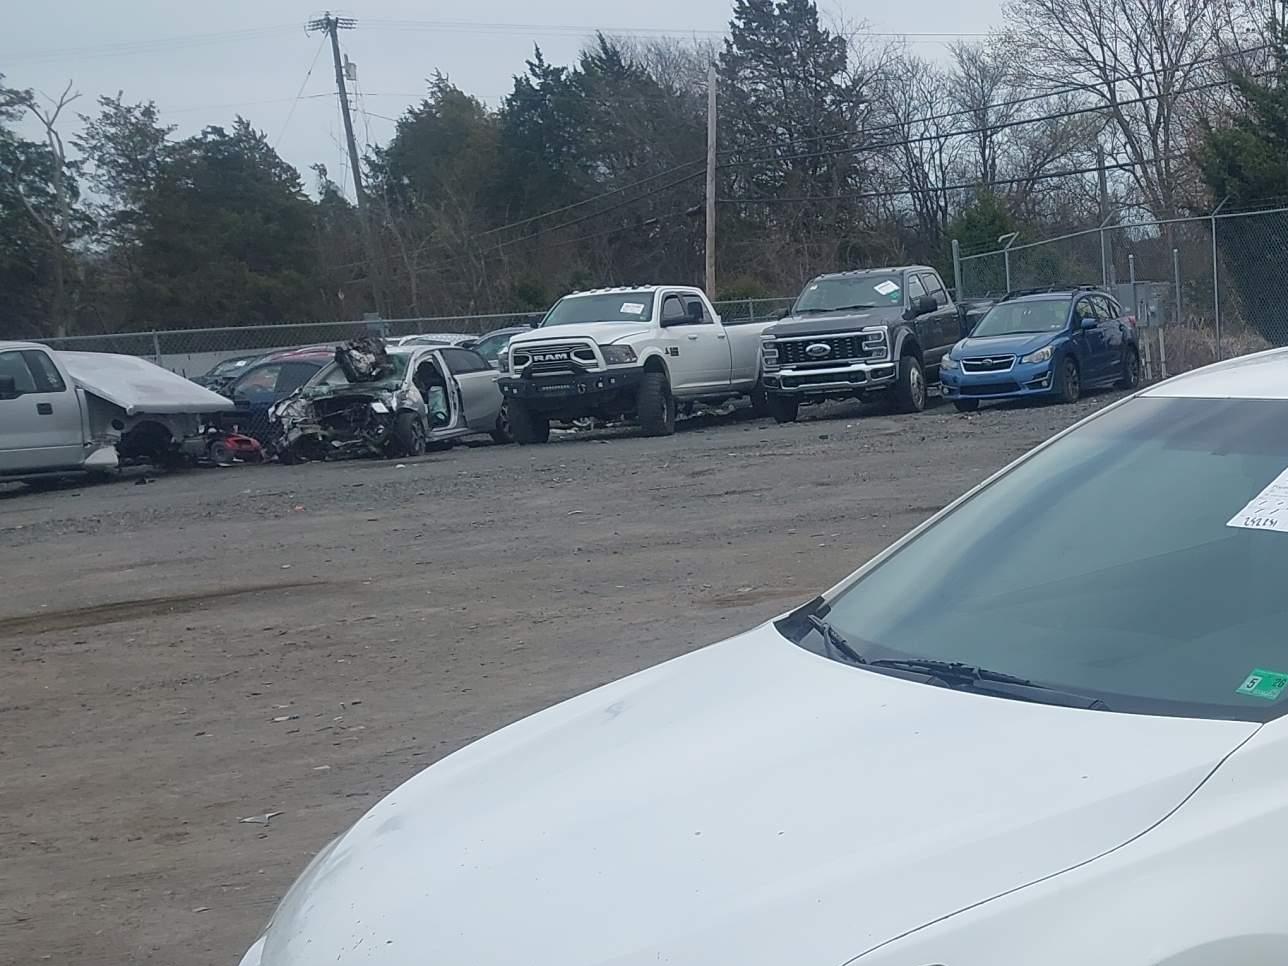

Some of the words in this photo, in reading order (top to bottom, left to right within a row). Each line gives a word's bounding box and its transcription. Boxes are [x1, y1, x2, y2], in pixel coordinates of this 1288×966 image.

[533, 353, 568, 361] RAM
[1246, 679, 1258, 688] 5
[1272, 679, 1287, 688] 26
